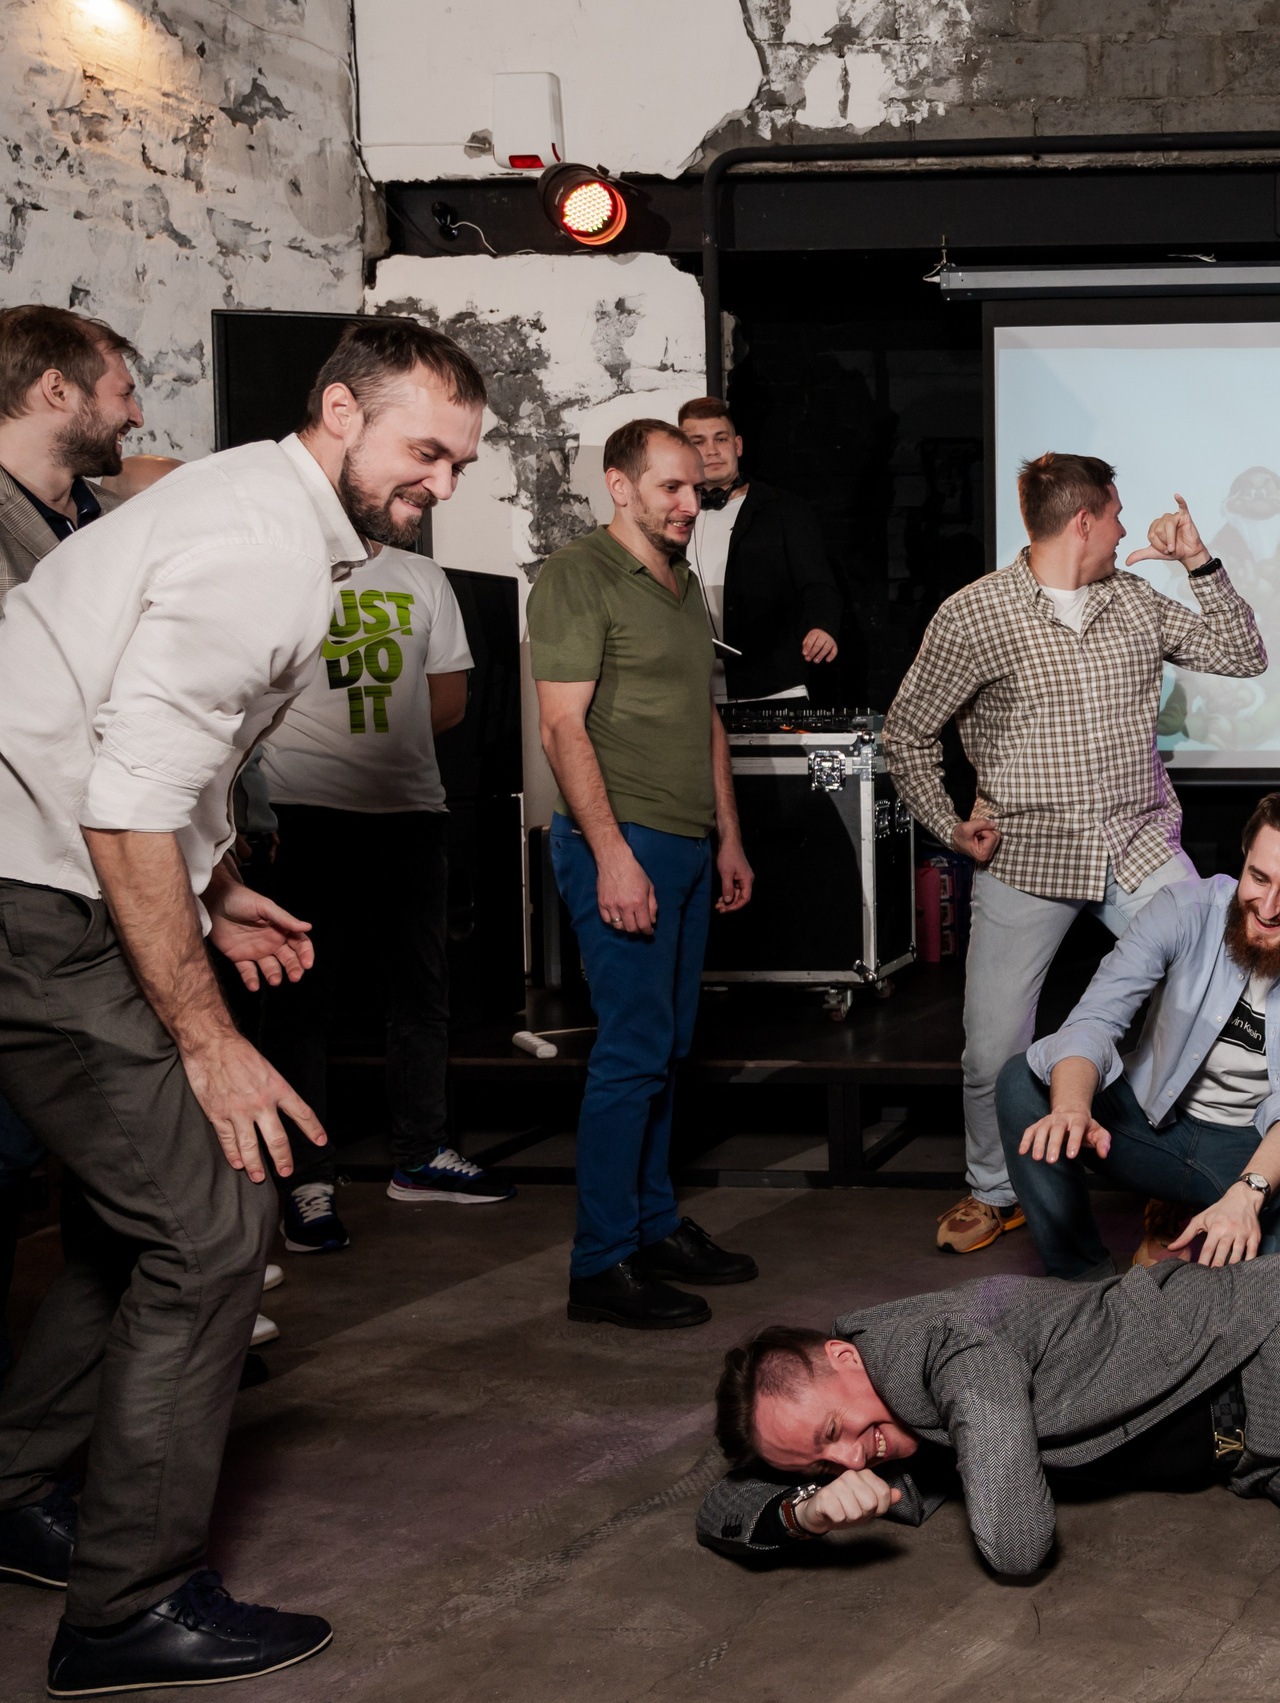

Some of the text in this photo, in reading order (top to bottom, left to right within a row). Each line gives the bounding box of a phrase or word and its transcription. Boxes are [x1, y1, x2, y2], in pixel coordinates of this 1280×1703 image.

[328, 589, 415, 639] UST
[325, 636, 403, 690] DO
[347, 685, 393, 734] IT
[1243, 1021, 1262, 1041] Klein
